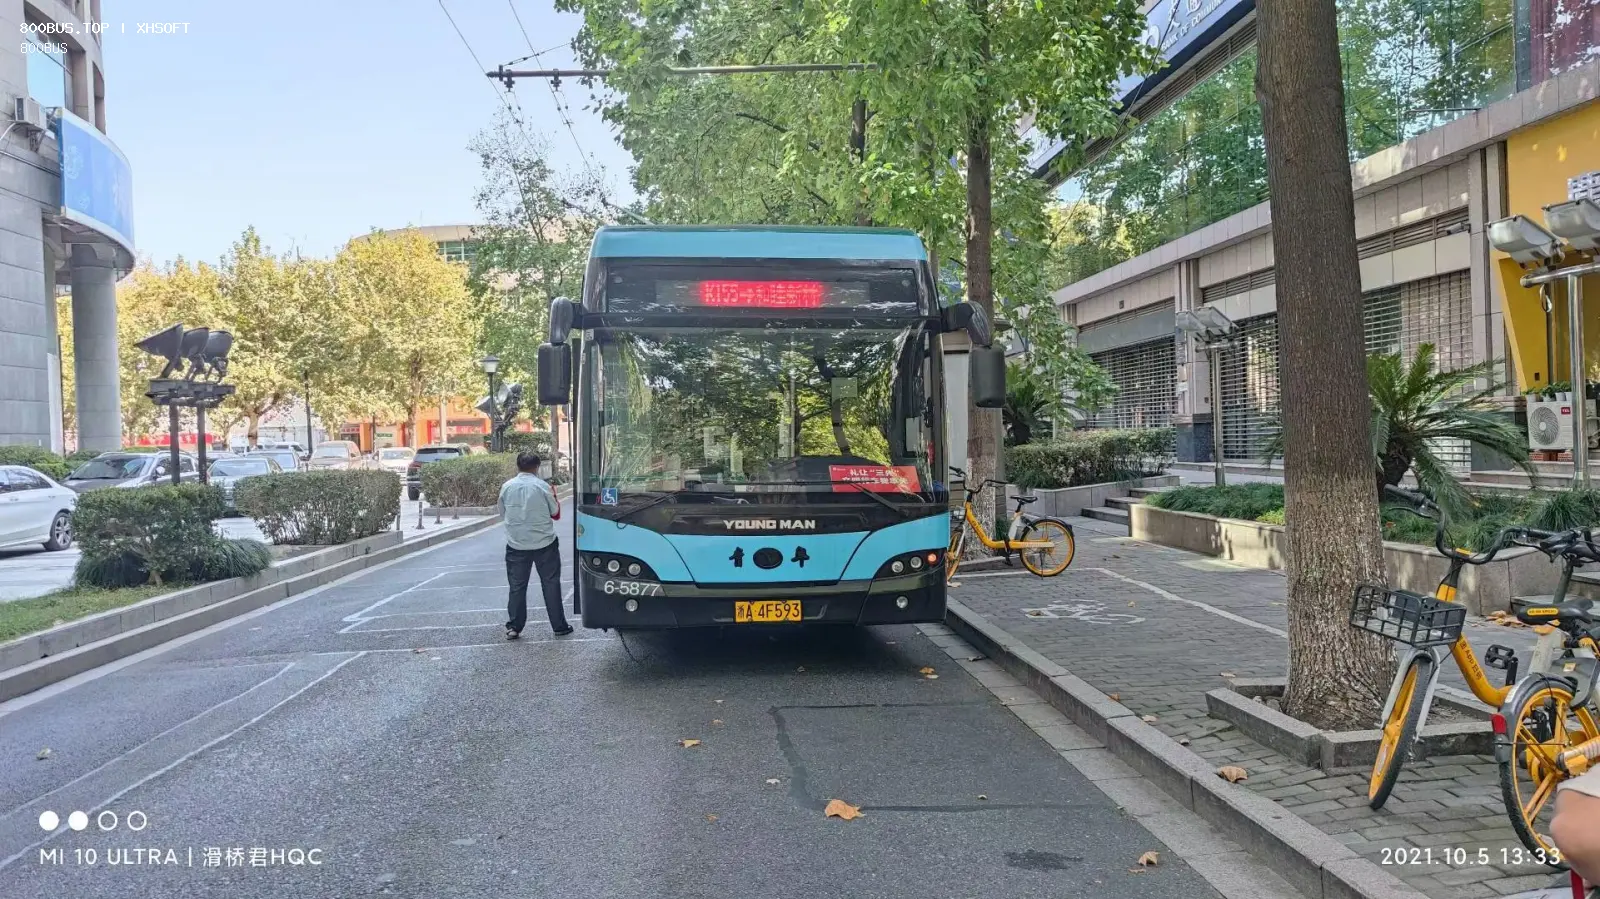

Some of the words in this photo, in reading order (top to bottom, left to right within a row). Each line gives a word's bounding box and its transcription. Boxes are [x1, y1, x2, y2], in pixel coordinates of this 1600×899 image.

[723, 519, 777, 530] YOUNG
[779, 519, 816, 530] MAN
[604, 580, 661, 597] 6-5877
